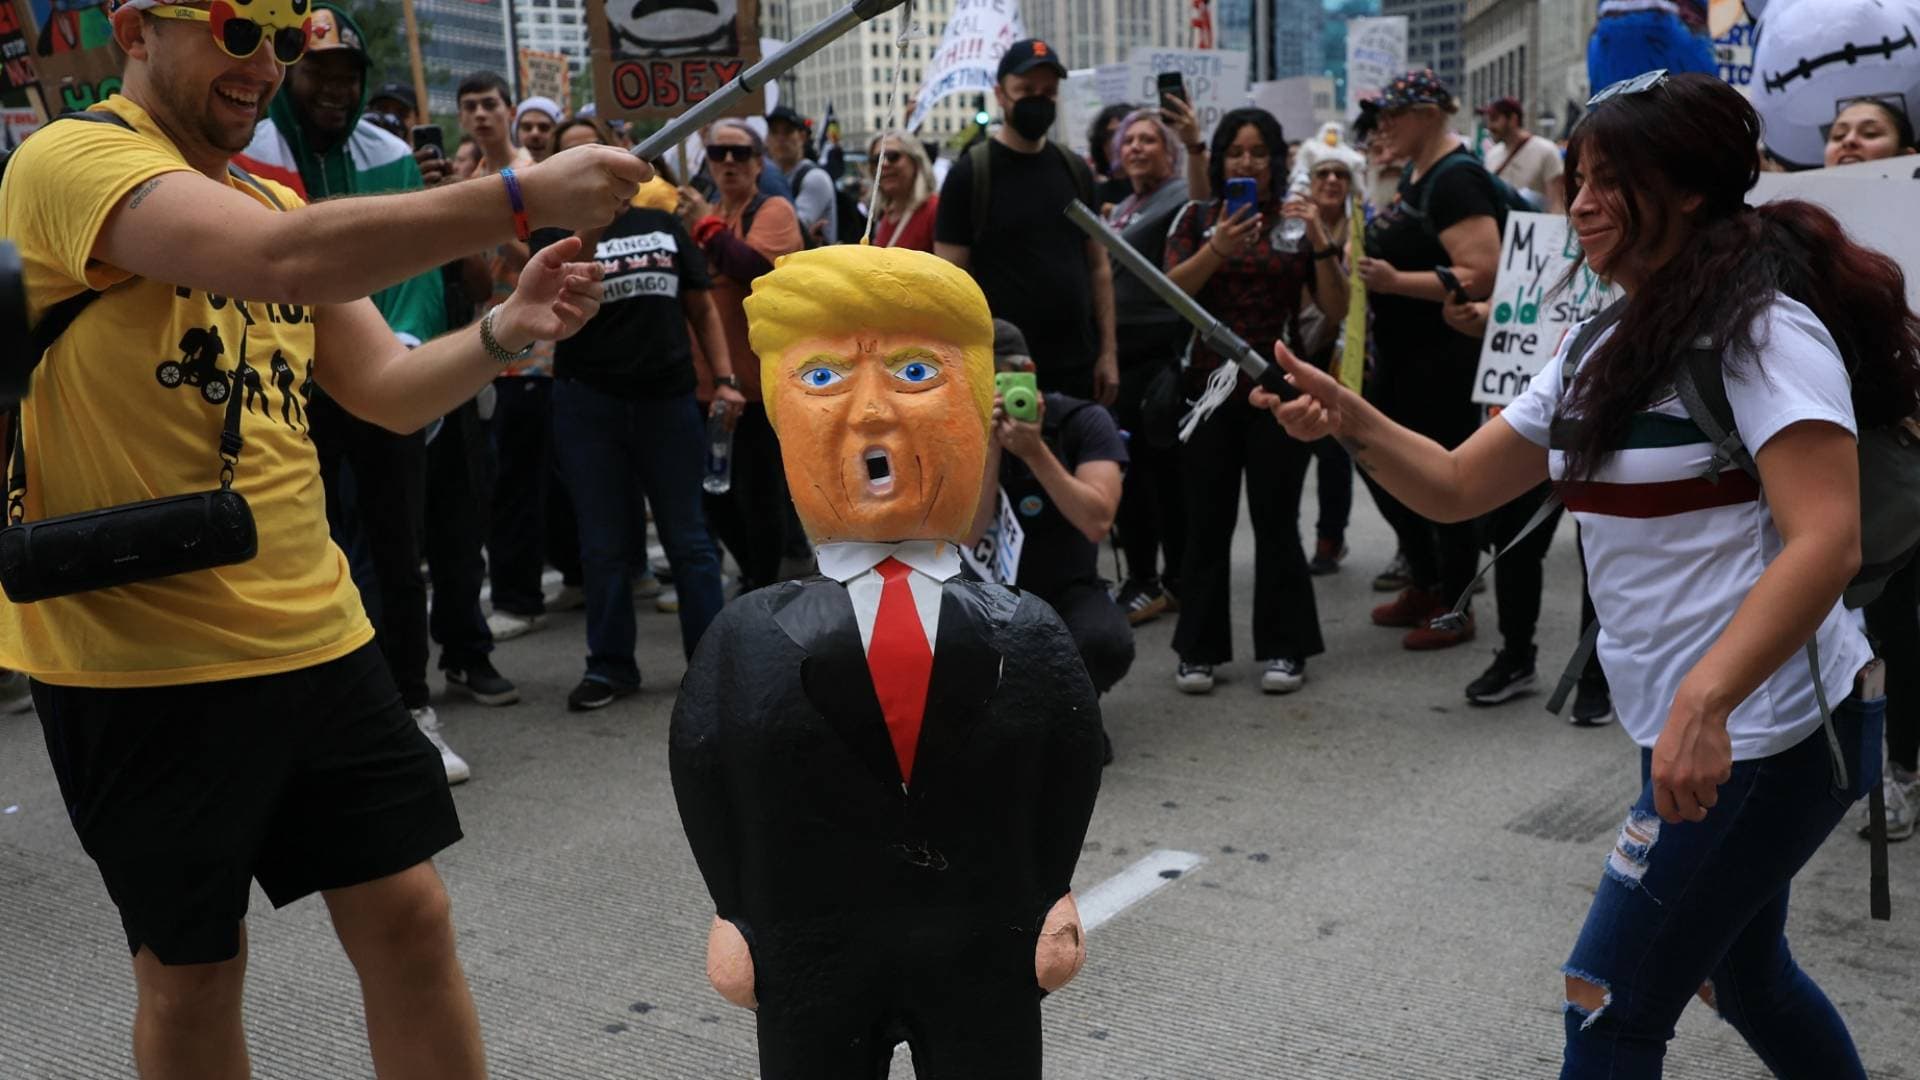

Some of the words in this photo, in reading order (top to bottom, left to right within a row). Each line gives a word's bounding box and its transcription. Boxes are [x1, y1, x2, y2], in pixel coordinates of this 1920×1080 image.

[613, 60, 743, 109] OBEY
[605, 234, 662, 254] KINGS
[1506, 221, 1549, 297] My
[1494, 286, 1543, 326] old
[1491, 330, 1538, 356] are
